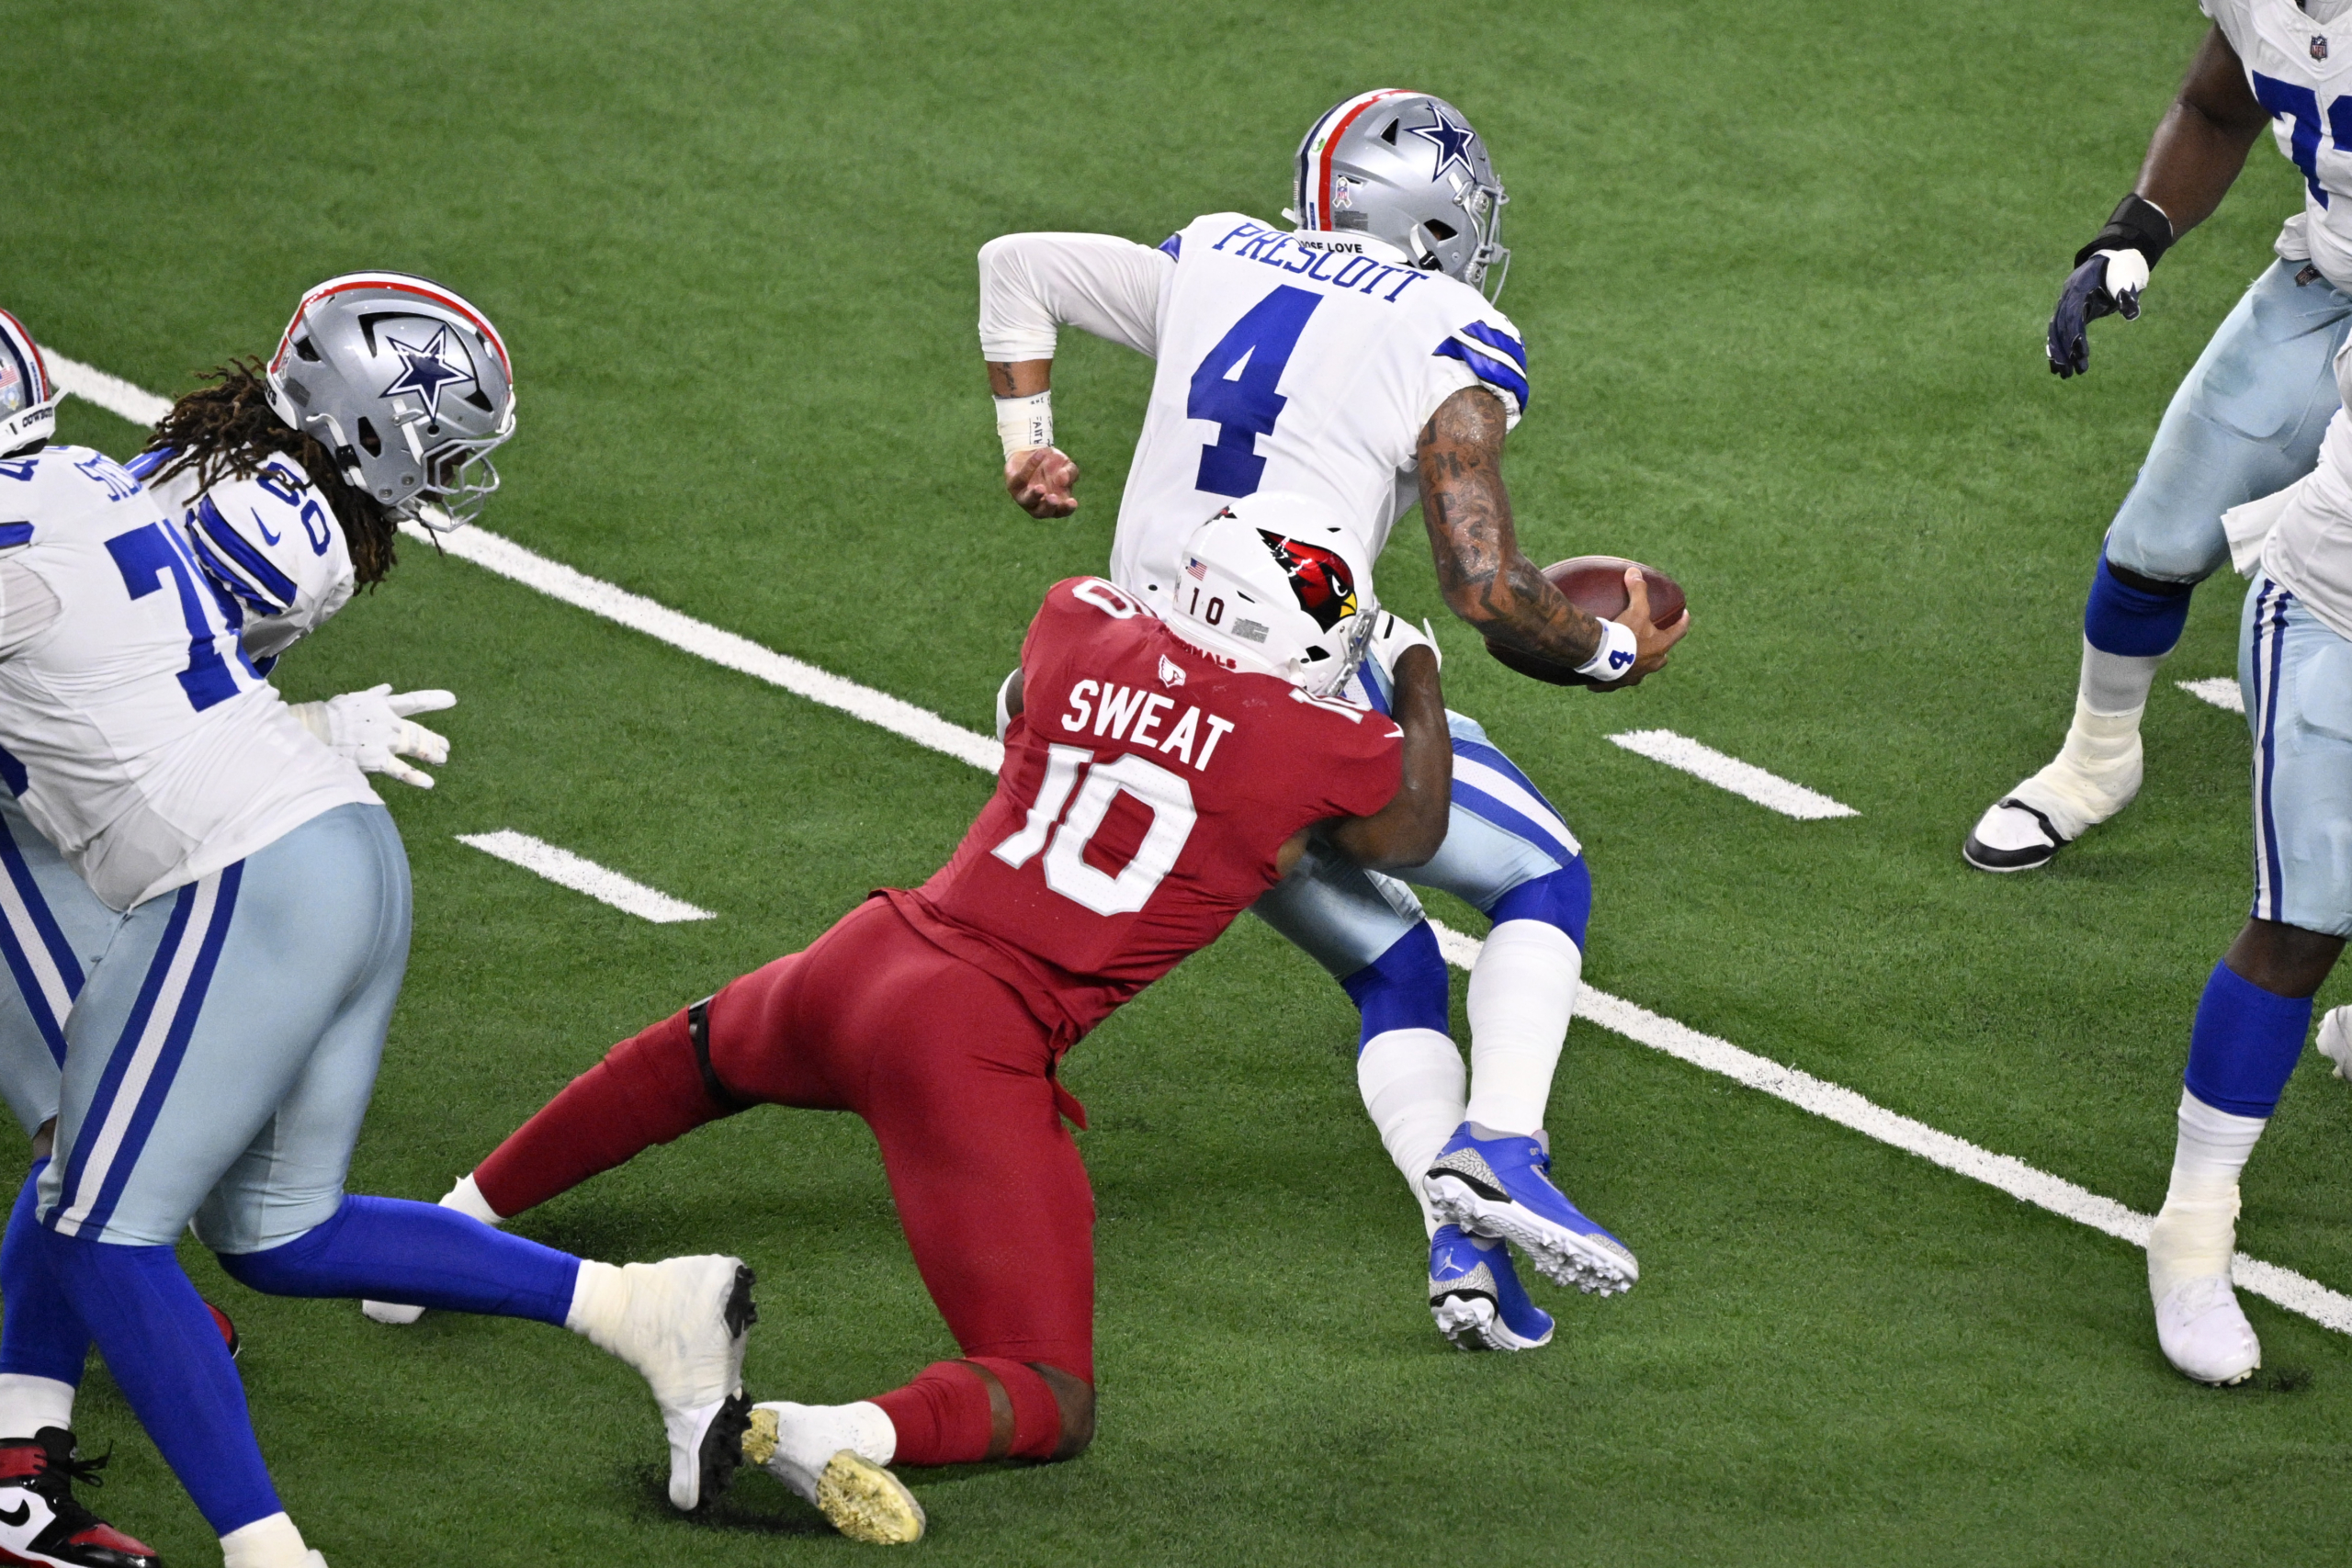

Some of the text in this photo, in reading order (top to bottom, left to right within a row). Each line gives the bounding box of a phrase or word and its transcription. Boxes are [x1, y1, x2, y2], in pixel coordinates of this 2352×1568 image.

[1212, 222, 1430, 303] PRESCOTT
[1328, 243, 1363, 254] LOVE
[1187, 284, 1324, 498] 4
[1190, 586, 1225, 626] 10
[1609, 649, 1634, 670] 4
[1060, 678, 1234, 772] SWEAT
[991, 742, 1197, 918] 10
